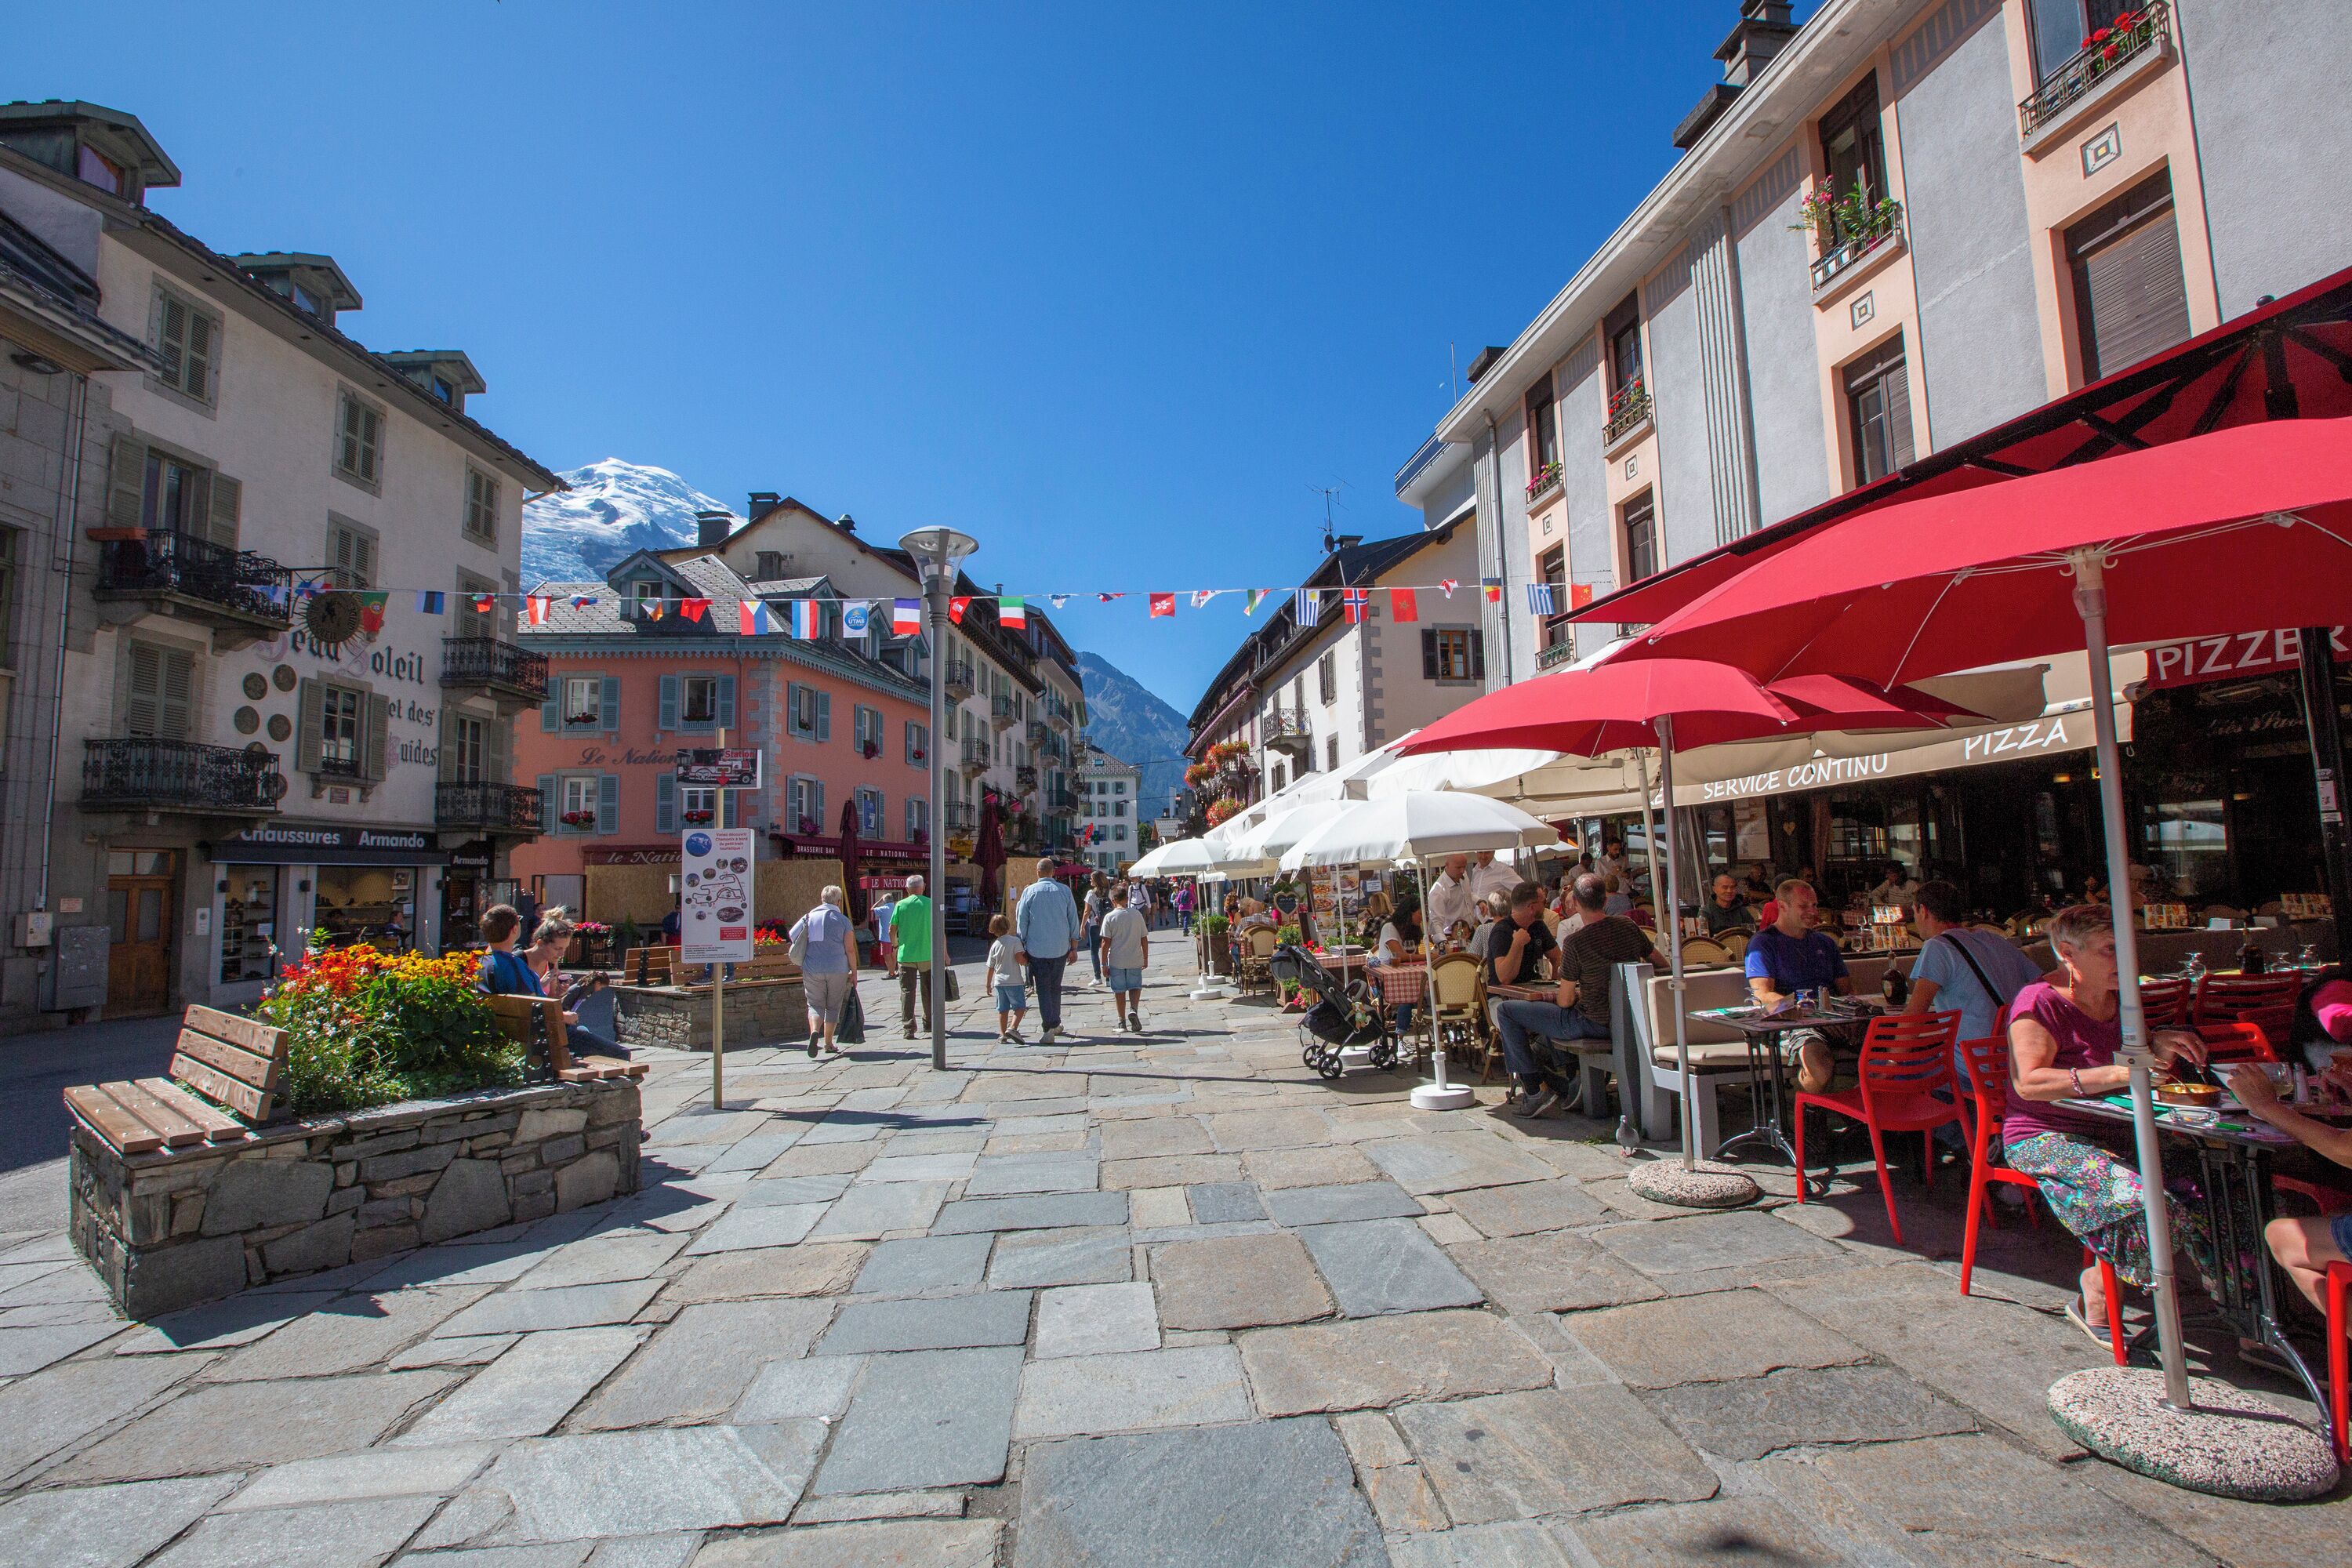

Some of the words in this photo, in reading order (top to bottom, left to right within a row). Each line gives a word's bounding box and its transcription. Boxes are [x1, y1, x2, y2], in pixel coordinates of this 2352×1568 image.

[408, 700, 436, 727] des
[1963, 718, 2068, 760] PIZZA
[579, 747, 607, 766] Le
[612, 747, 677, 766] Nation
[1704, 771, 1780, 800] SERVICE
[1788, 753, 1889, 786] CONTINU
[358, 830, 425, 848] Armando
[607, 851, 624, 864] le
[630, 851, 682, 865] Natio
[797, 845, 823, 854] BRASSERIE
[452, 855, 488, 866] Armando
[871, 878, 879, 887] LE
[883, 878, 907, 887] NATIO
